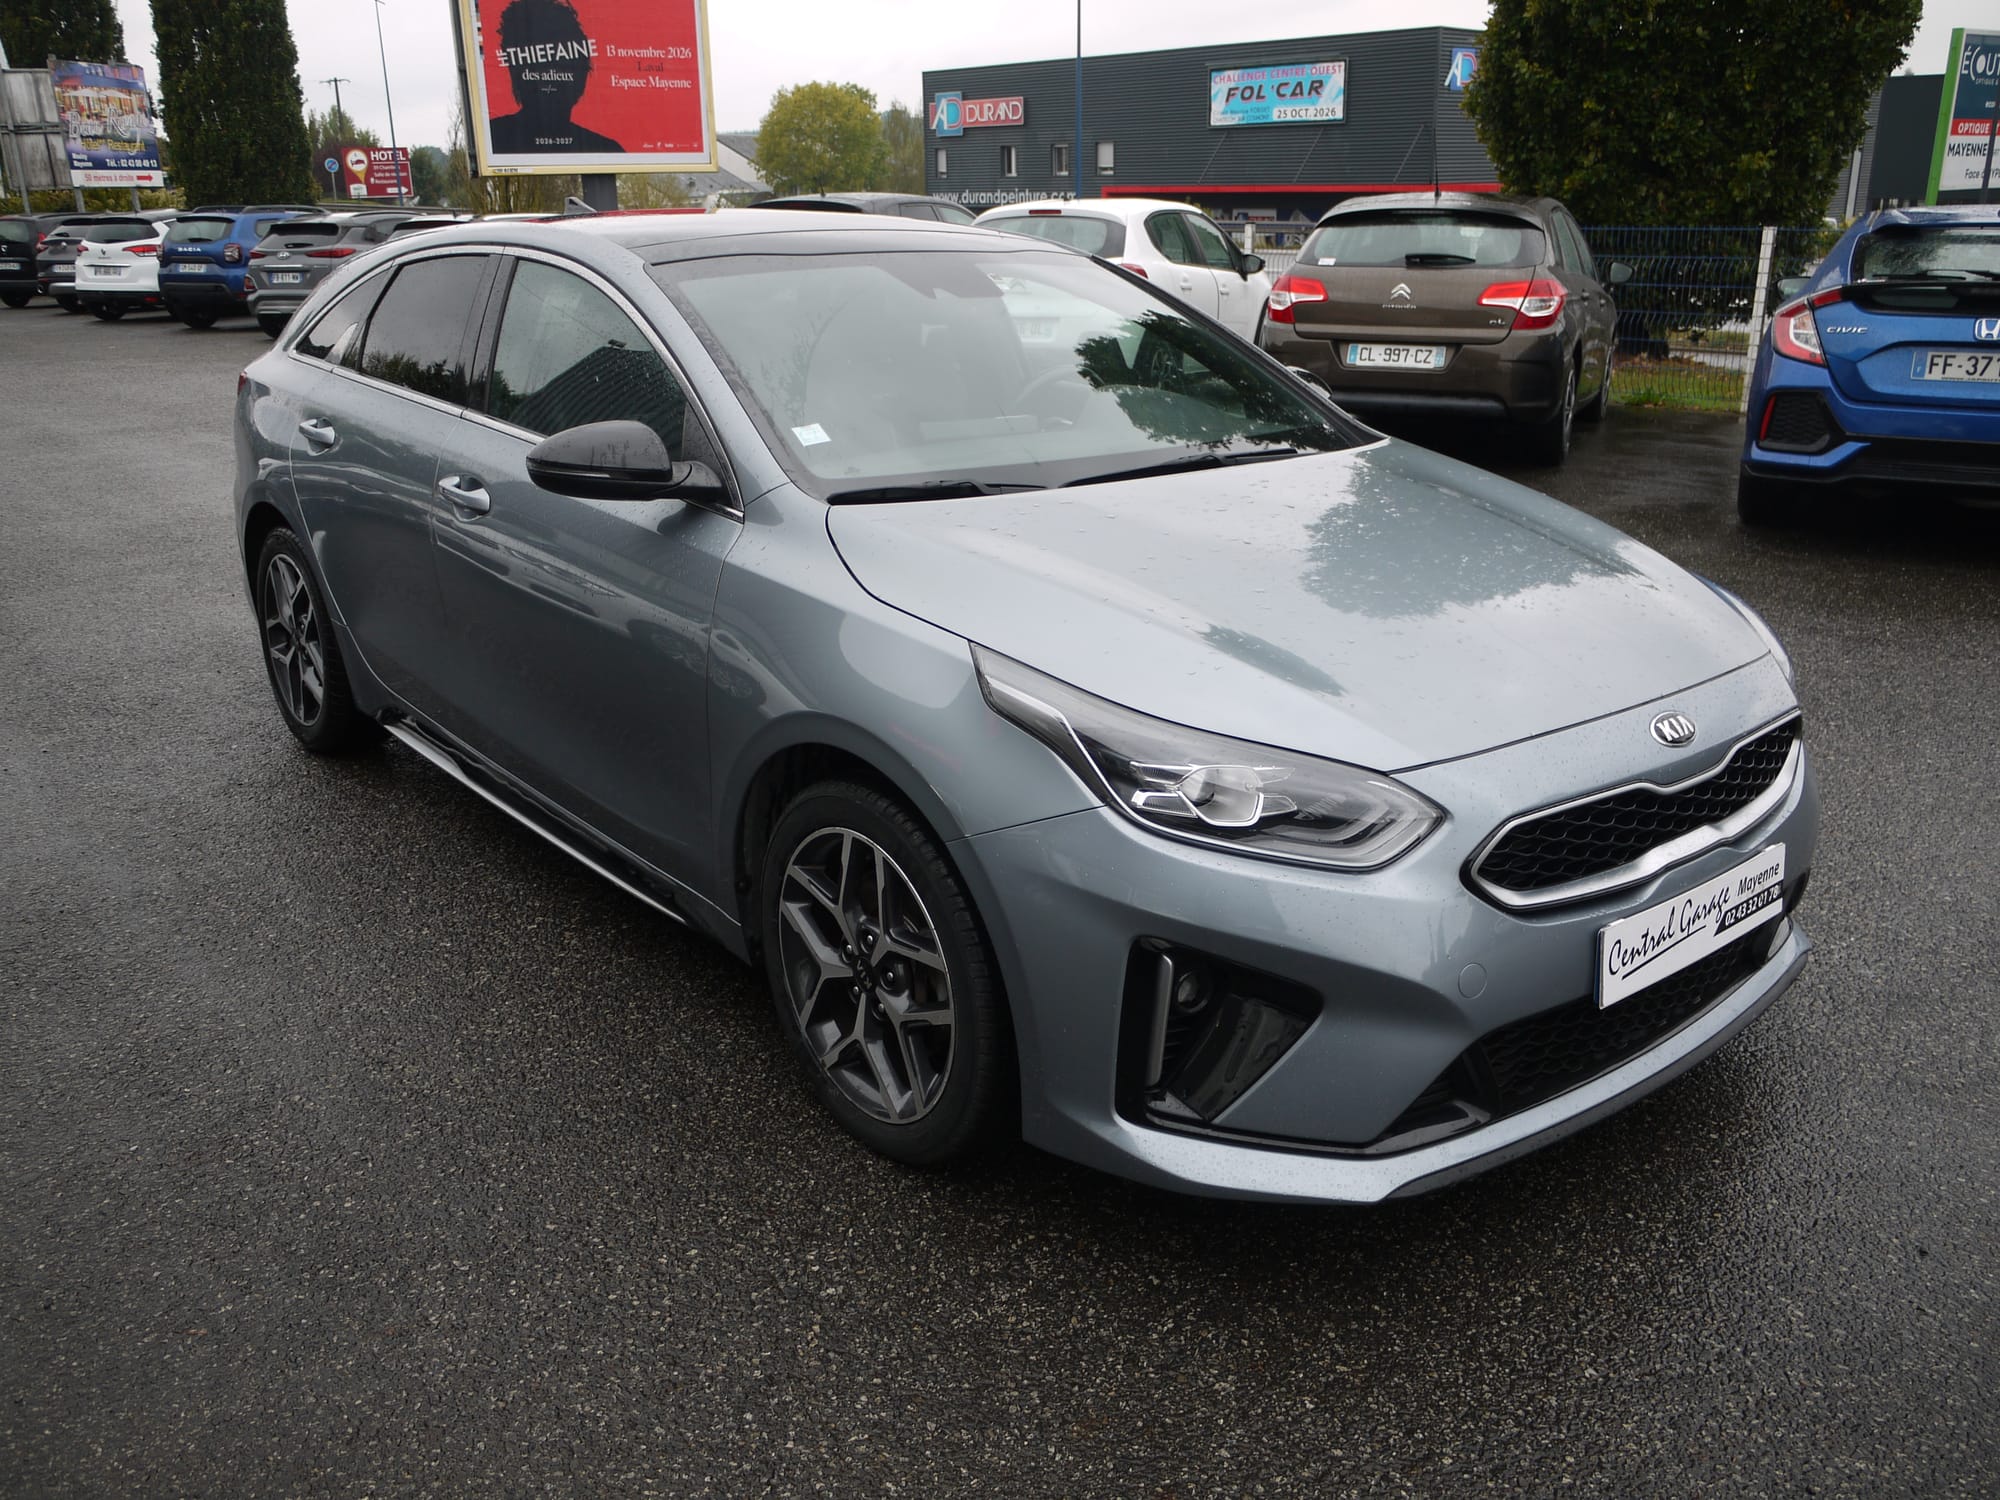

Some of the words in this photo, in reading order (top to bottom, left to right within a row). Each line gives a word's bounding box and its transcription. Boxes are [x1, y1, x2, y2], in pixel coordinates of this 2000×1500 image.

[507, 39, 599, 66] THIEFAINE
[606, 45, 616, 57] 13
[617, 46, 667, 59] novembre
[667, 47, 692, 60] 2026
[637, 61, 664, 73] Laval
[1213, 71, 1267, 85] CHALLENGE
[1270, 67, 1306, 79] CENTRE
[1310, 64, 1343, 75] OUEST
[522, 69, 540, 81] des
[541, 69, 574, 82] adieux
[611, 75, 647, 89] Espace
[648, 76, 692, 91] Mayenne
[931, 97, 962, 130] AD
[965, 101, 1022, 123] DURAND
[1277, 109, 1288, 119] 25
[1290, 108, 1312, 118] OCT.
[1313, 107, 1337, 118] 2026
[1957, 122, 1990, 134] OPTIQUE
[535, 137, 573, 145] 2026-2027
[370, 150, 406, 161] HOTEL
[1946, 142, 1989, 157] MAYENNE
[1826, 326, 1868, 334] CIVIC
[1655, 715, 1695, 742] KIA
[1608, 905, 1676, 976] Central
[1680, 885, 1731, 937] Garage
[1737, 862, 1780, 896] Mayenne
